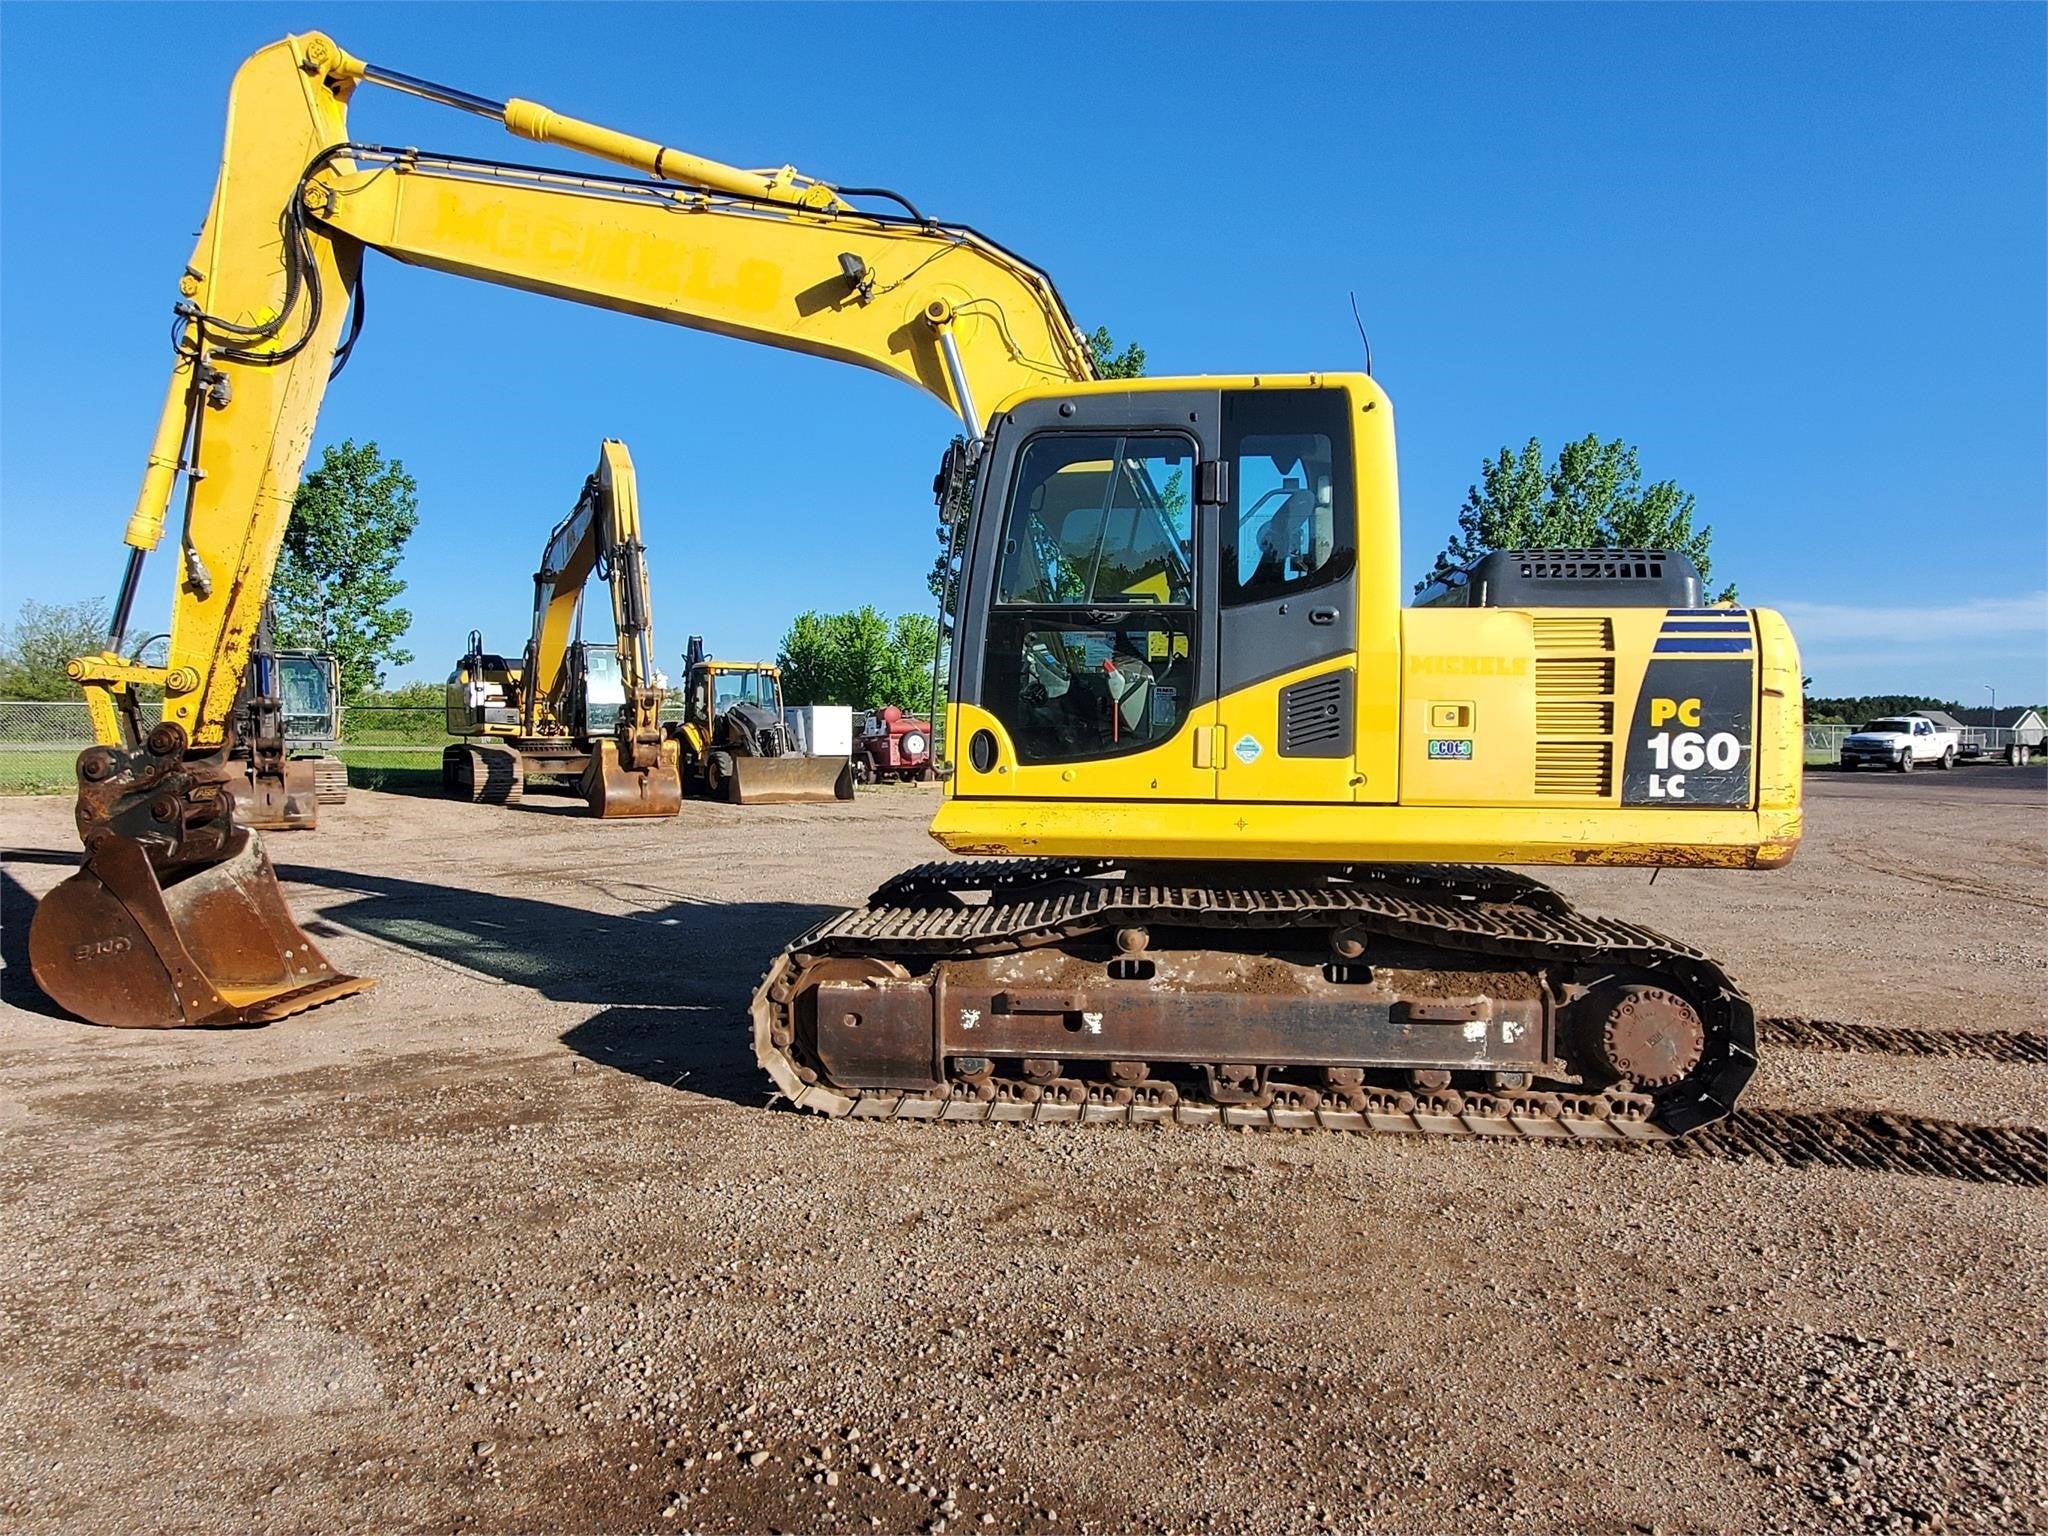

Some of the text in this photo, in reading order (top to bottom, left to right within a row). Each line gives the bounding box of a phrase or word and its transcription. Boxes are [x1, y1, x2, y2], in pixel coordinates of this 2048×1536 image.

[1651, 698, 1701, 727] PC
[1647, 732, 1740, 771] 160
[1649, 774, 1685, 797] LC
